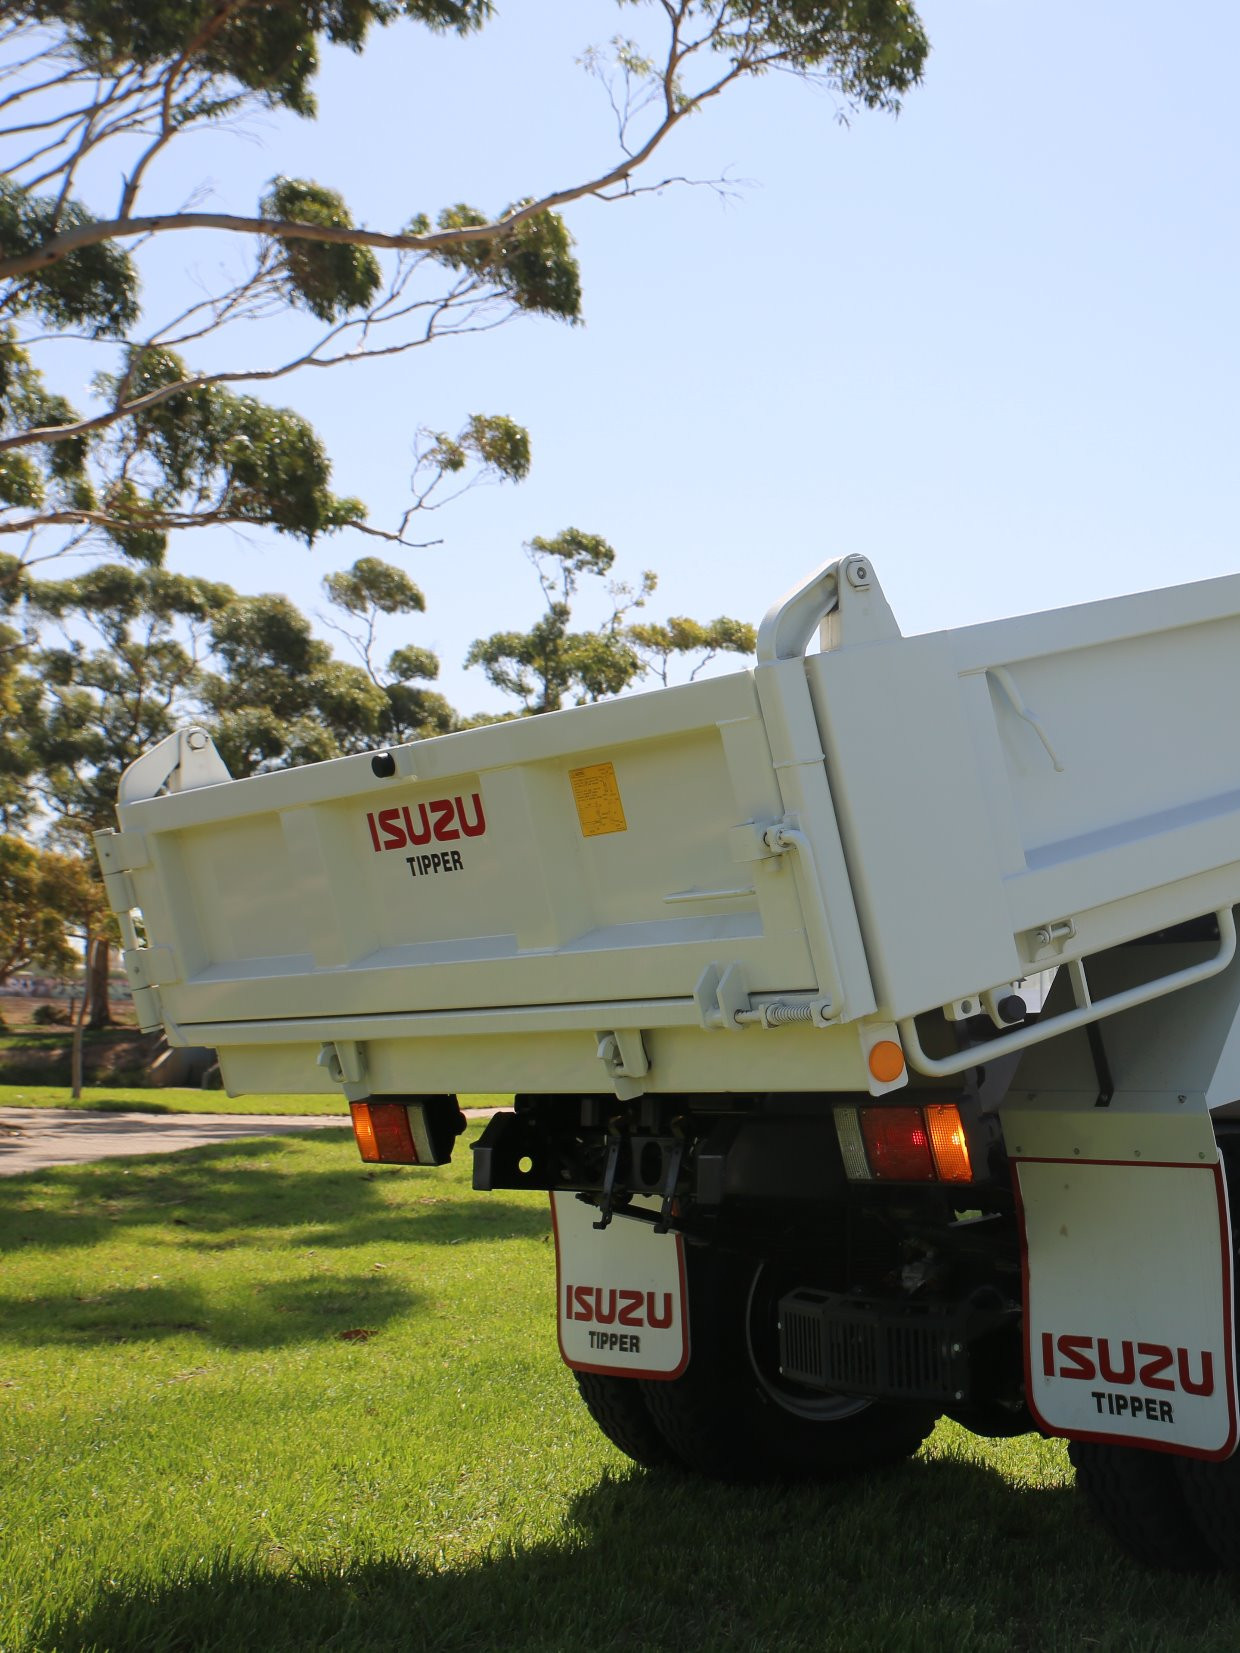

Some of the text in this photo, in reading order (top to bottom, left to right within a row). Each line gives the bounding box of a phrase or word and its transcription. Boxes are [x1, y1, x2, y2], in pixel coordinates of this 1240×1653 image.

[366, 793, 486, 852] ISUZU
[406, 850, 464, 877] TIPPER
[566, 1284, 673, 1329] ISUZU
[588, 1330, 641, 1353] TIPPER
[1041, 1332, 1214, 1397] ISUZU
[1091, 1391, 1174, 1424] TIPPER
